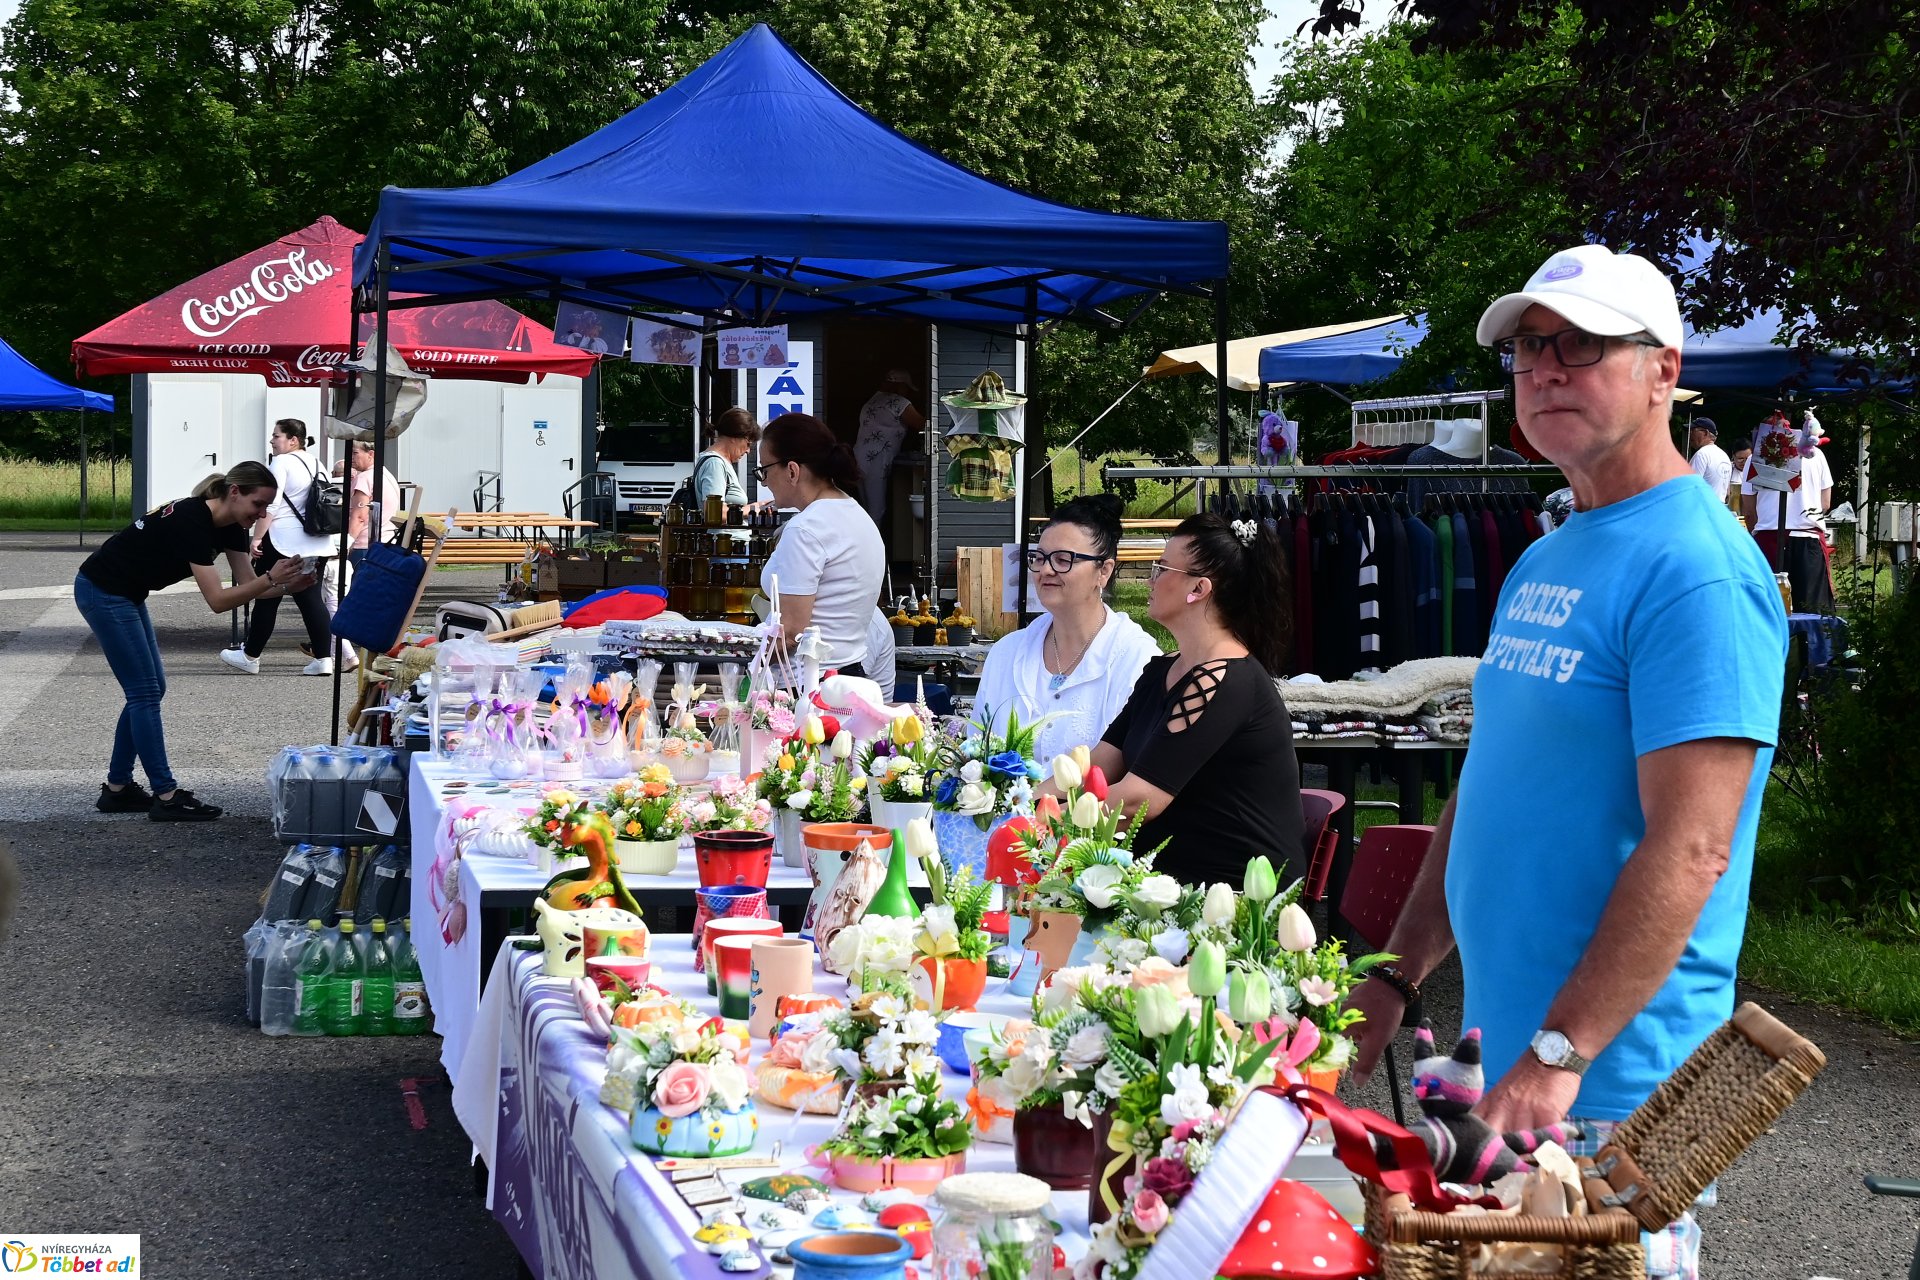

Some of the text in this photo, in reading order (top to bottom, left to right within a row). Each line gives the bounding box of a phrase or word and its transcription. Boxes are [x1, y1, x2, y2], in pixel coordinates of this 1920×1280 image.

[182, 247, 334, 338] Coca-Cola
[198, 344, 271, 355] ICE COLD
[412, 349, 498, 365] SOLD HERE
[1507, 582, 1583, 628] OMNIS
[1482, 634, 1585, 683] APITVÁNY
